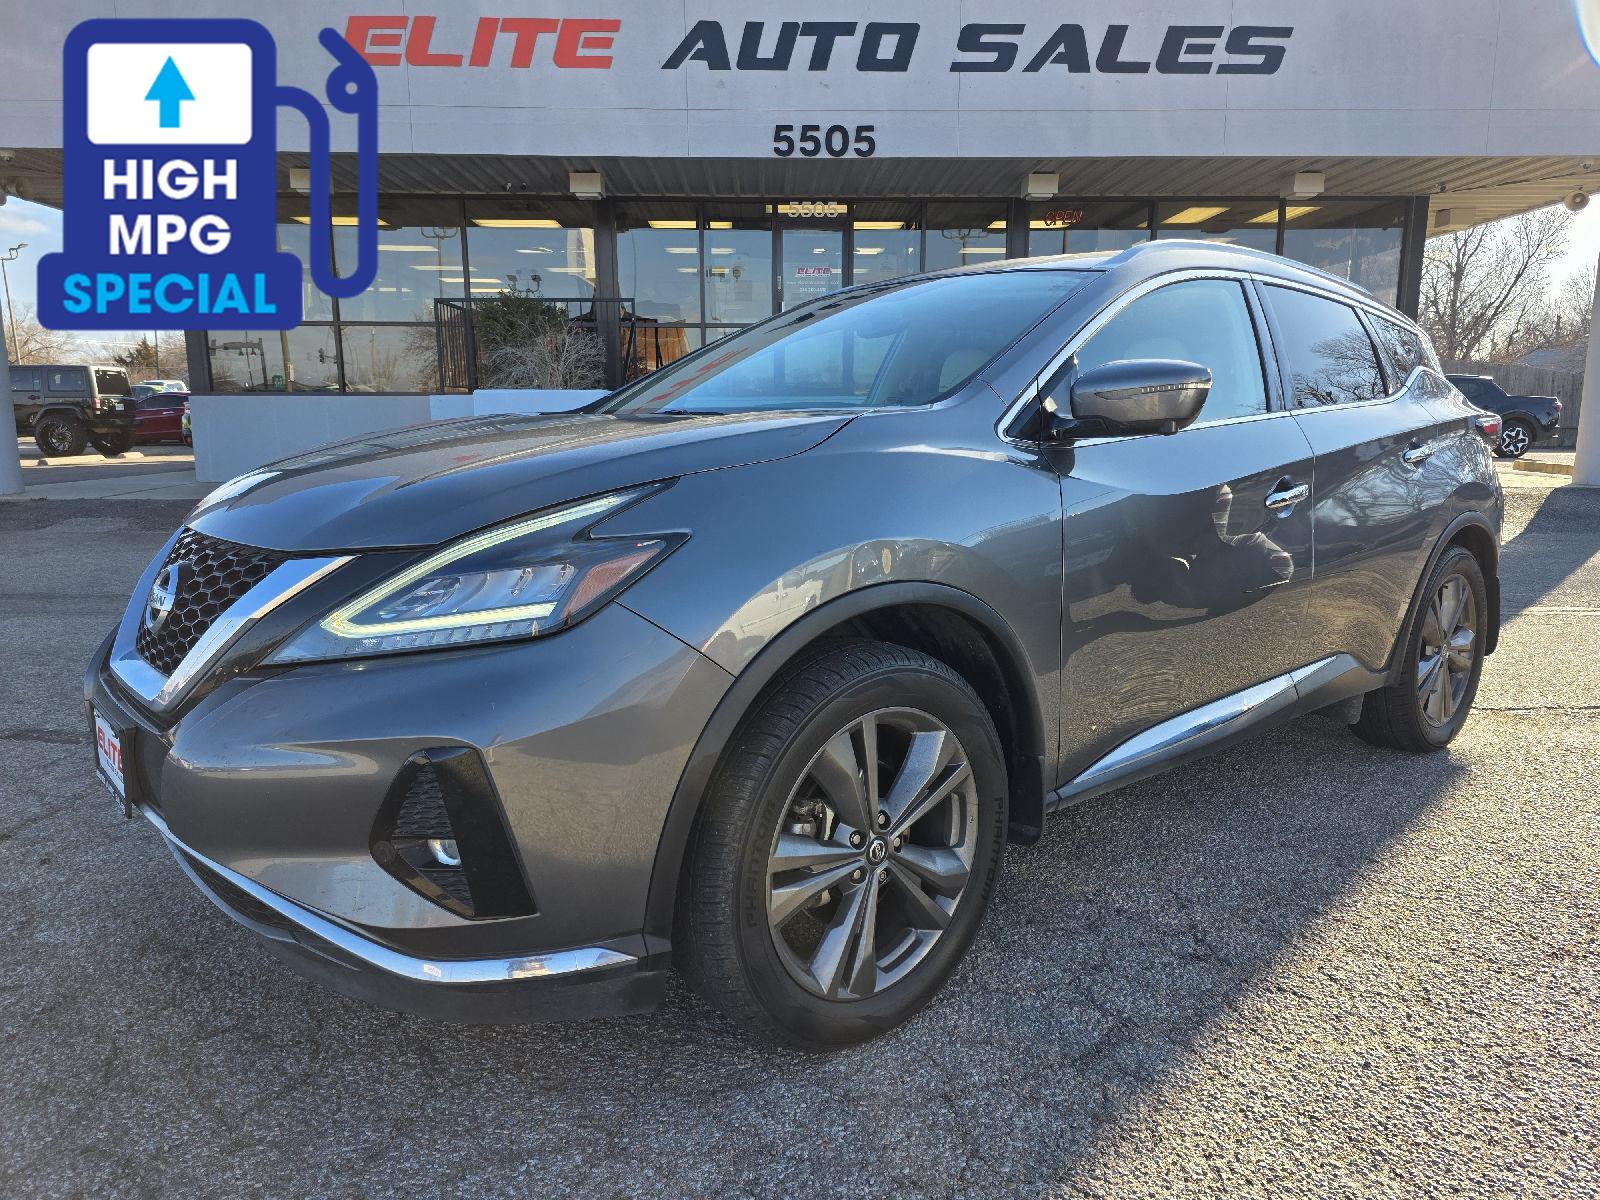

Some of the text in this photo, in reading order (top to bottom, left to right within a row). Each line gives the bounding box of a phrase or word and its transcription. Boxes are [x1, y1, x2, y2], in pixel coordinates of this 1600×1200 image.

[344, 16, 1294, 75] ELITE AUTO SALES
[773, 125, 877, 158] 5505
[787, 201, 839, 218] 5505
[1045, 210, 1083, 226] OPEN
